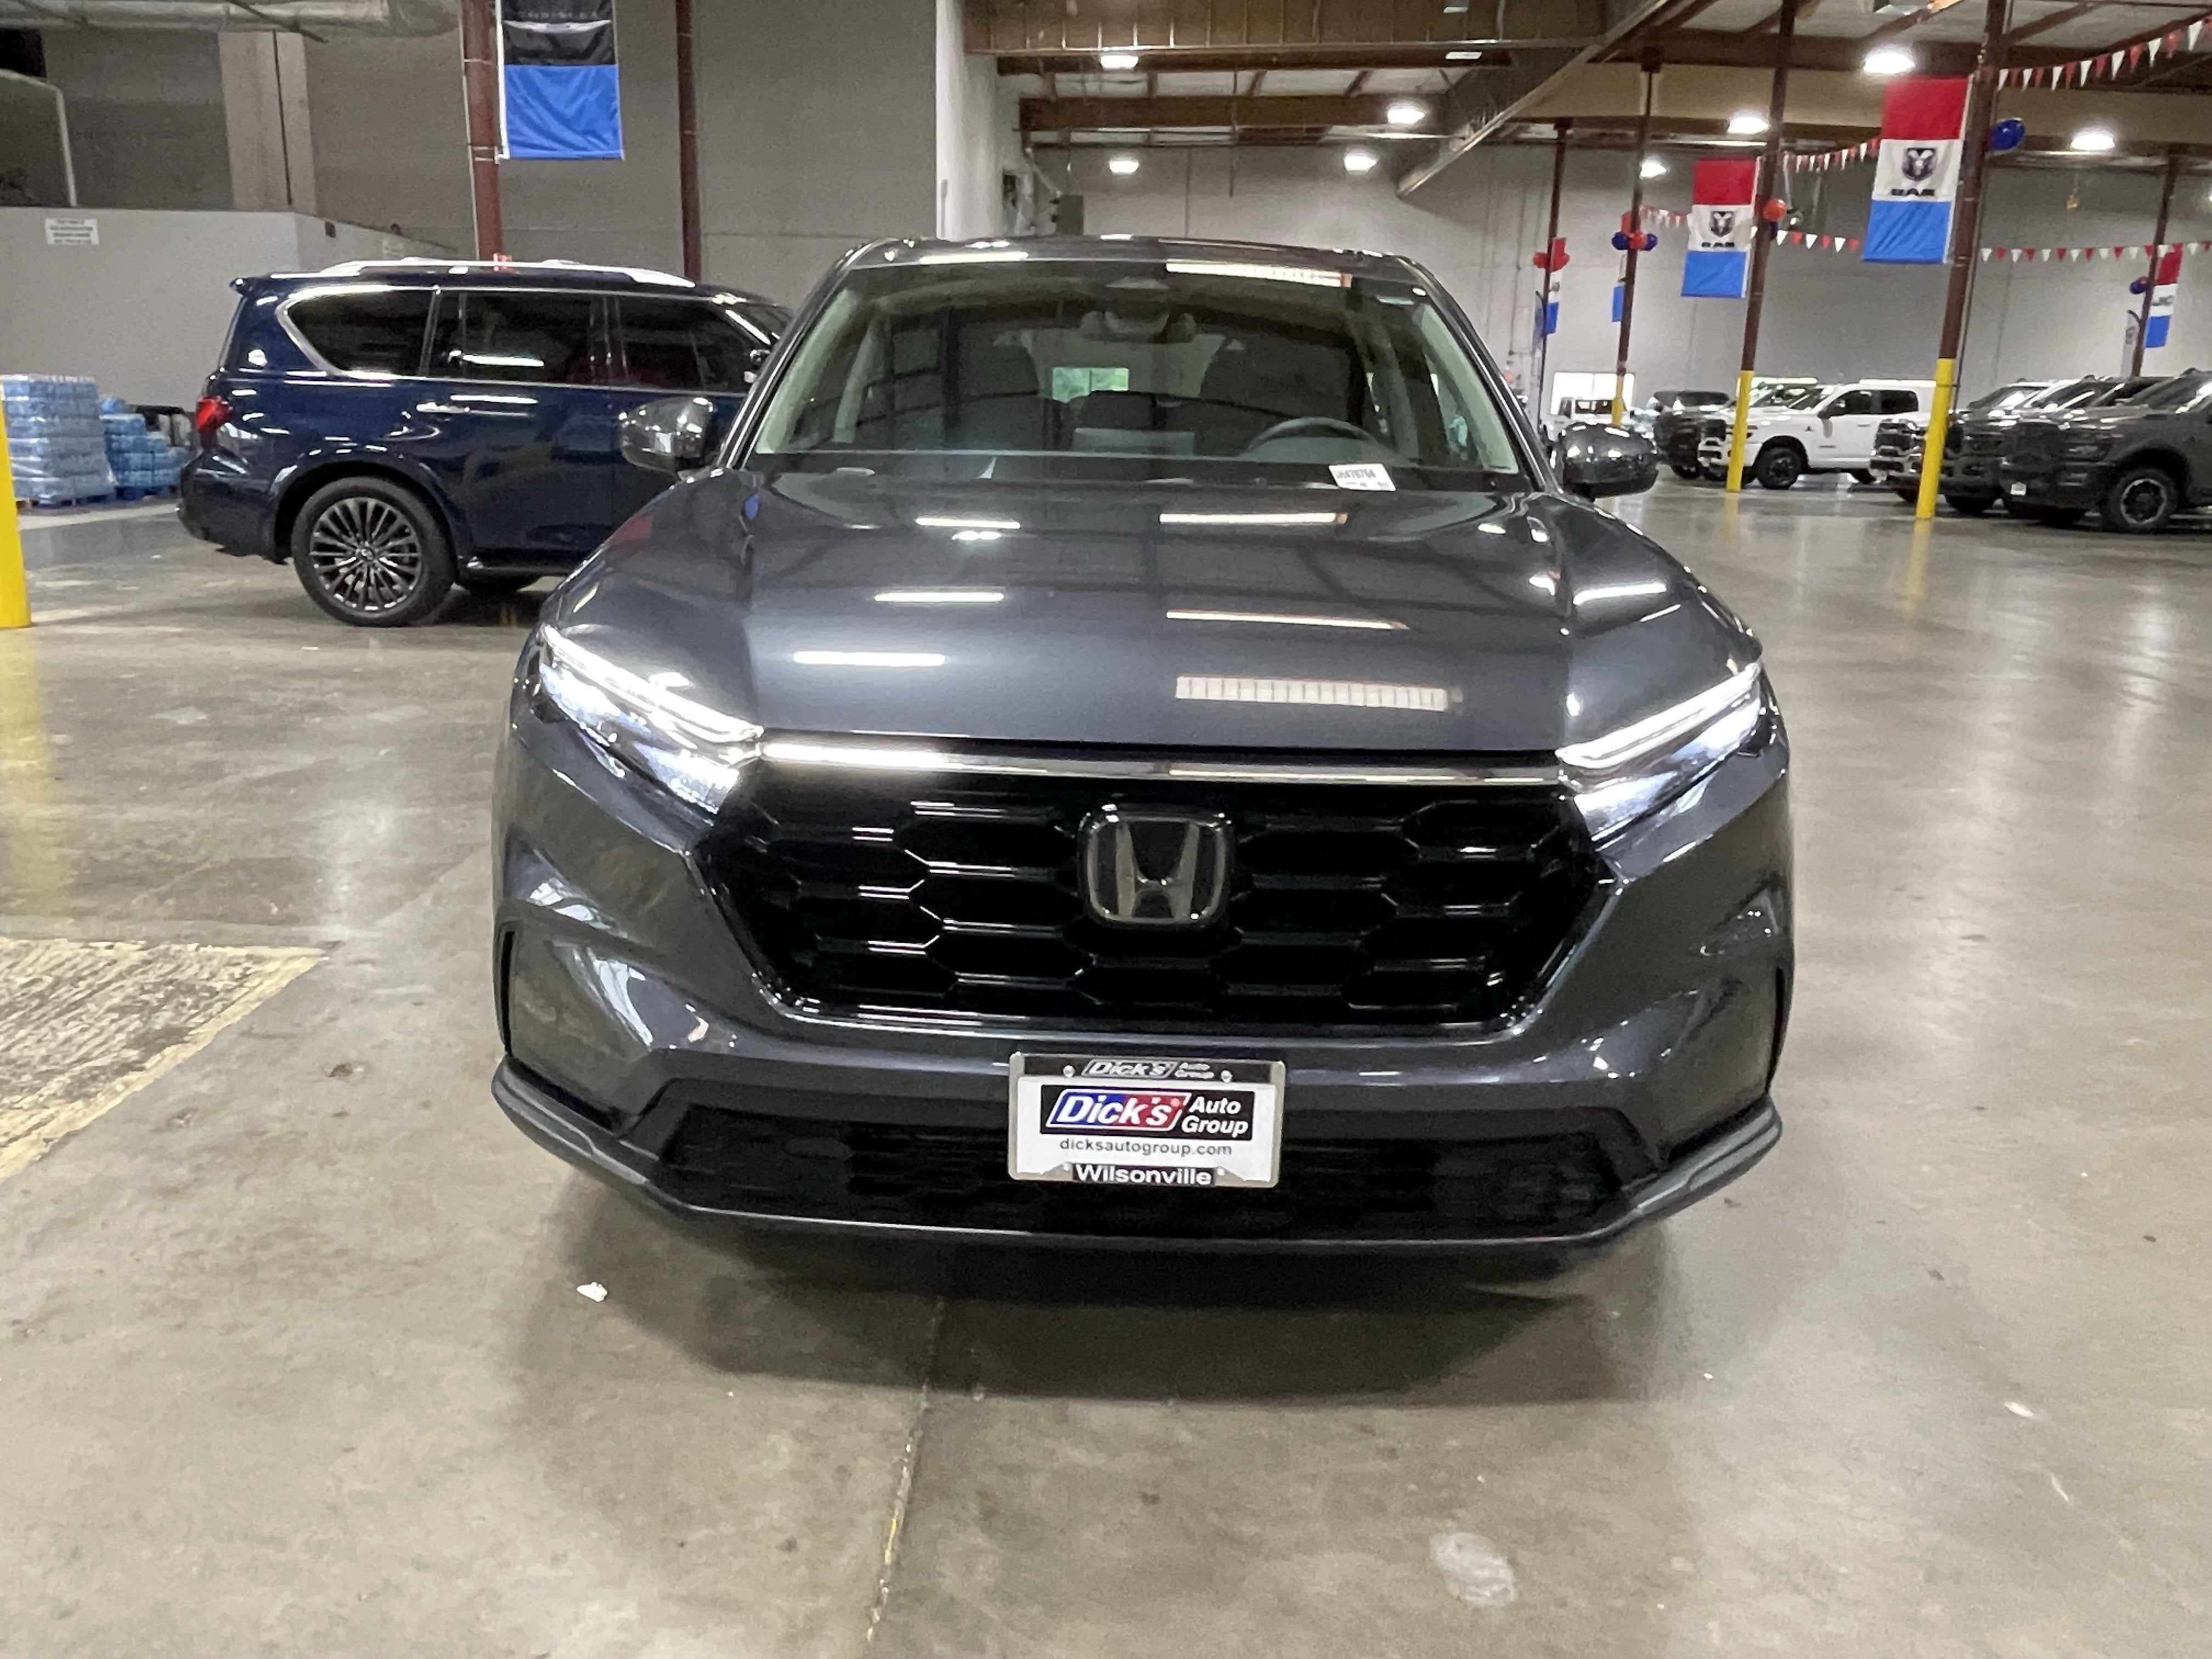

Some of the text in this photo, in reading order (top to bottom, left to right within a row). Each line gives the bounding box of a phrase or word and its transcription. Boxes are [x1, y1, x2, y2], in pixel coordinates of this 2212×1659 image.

[1056, 1096, 1242, 1126] Dick's Auto
[1182, 1116, 1248, 1138] Group
[1060, 1138, 1232, 1156] dicksautogroup.com
[1075, 1164, 1211, 1186] Wilsonville
